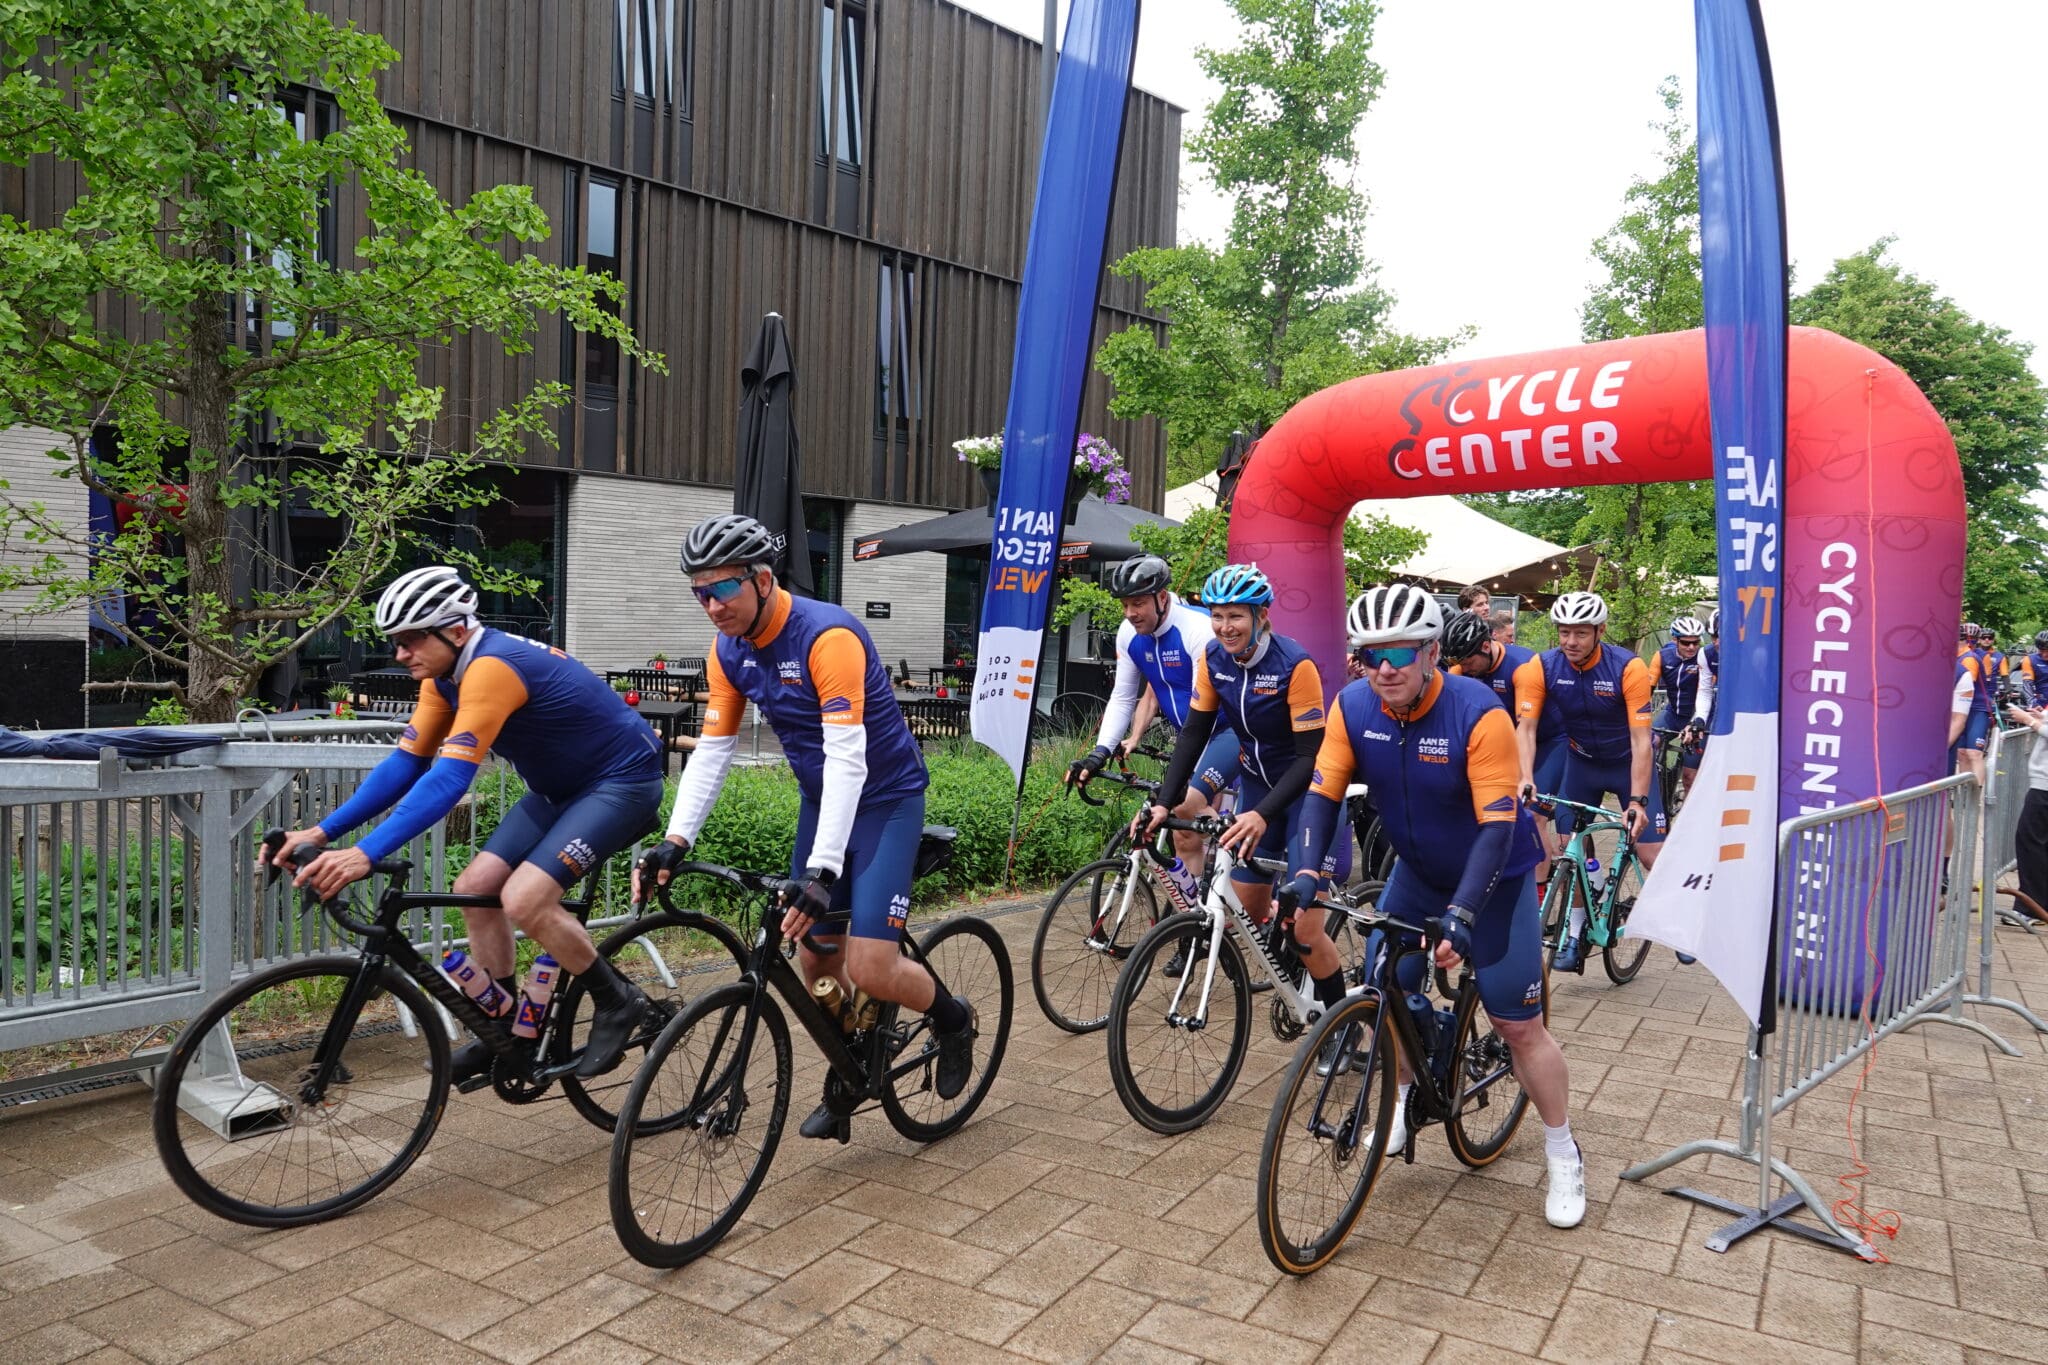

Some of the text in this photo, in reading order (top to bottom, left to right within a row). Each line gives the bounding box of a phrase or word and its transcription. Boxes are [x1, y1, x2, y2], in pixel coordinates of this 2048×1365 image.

[1444, 361, 1633, 425] CYCLE
[1388, 421, 1623, 480] CENTER
[1363, 730, 1392, 742] Santini
[1418, 737, 1449, 746] AAN DE
[1418, 746, 1449, 755] STEGGE
[1418, 754, 1449, 764] TWELLO
[1152, 862, 1191, 913] SPECIALIZE
[1235, 905, 1291, 984] SPECIALIZED
